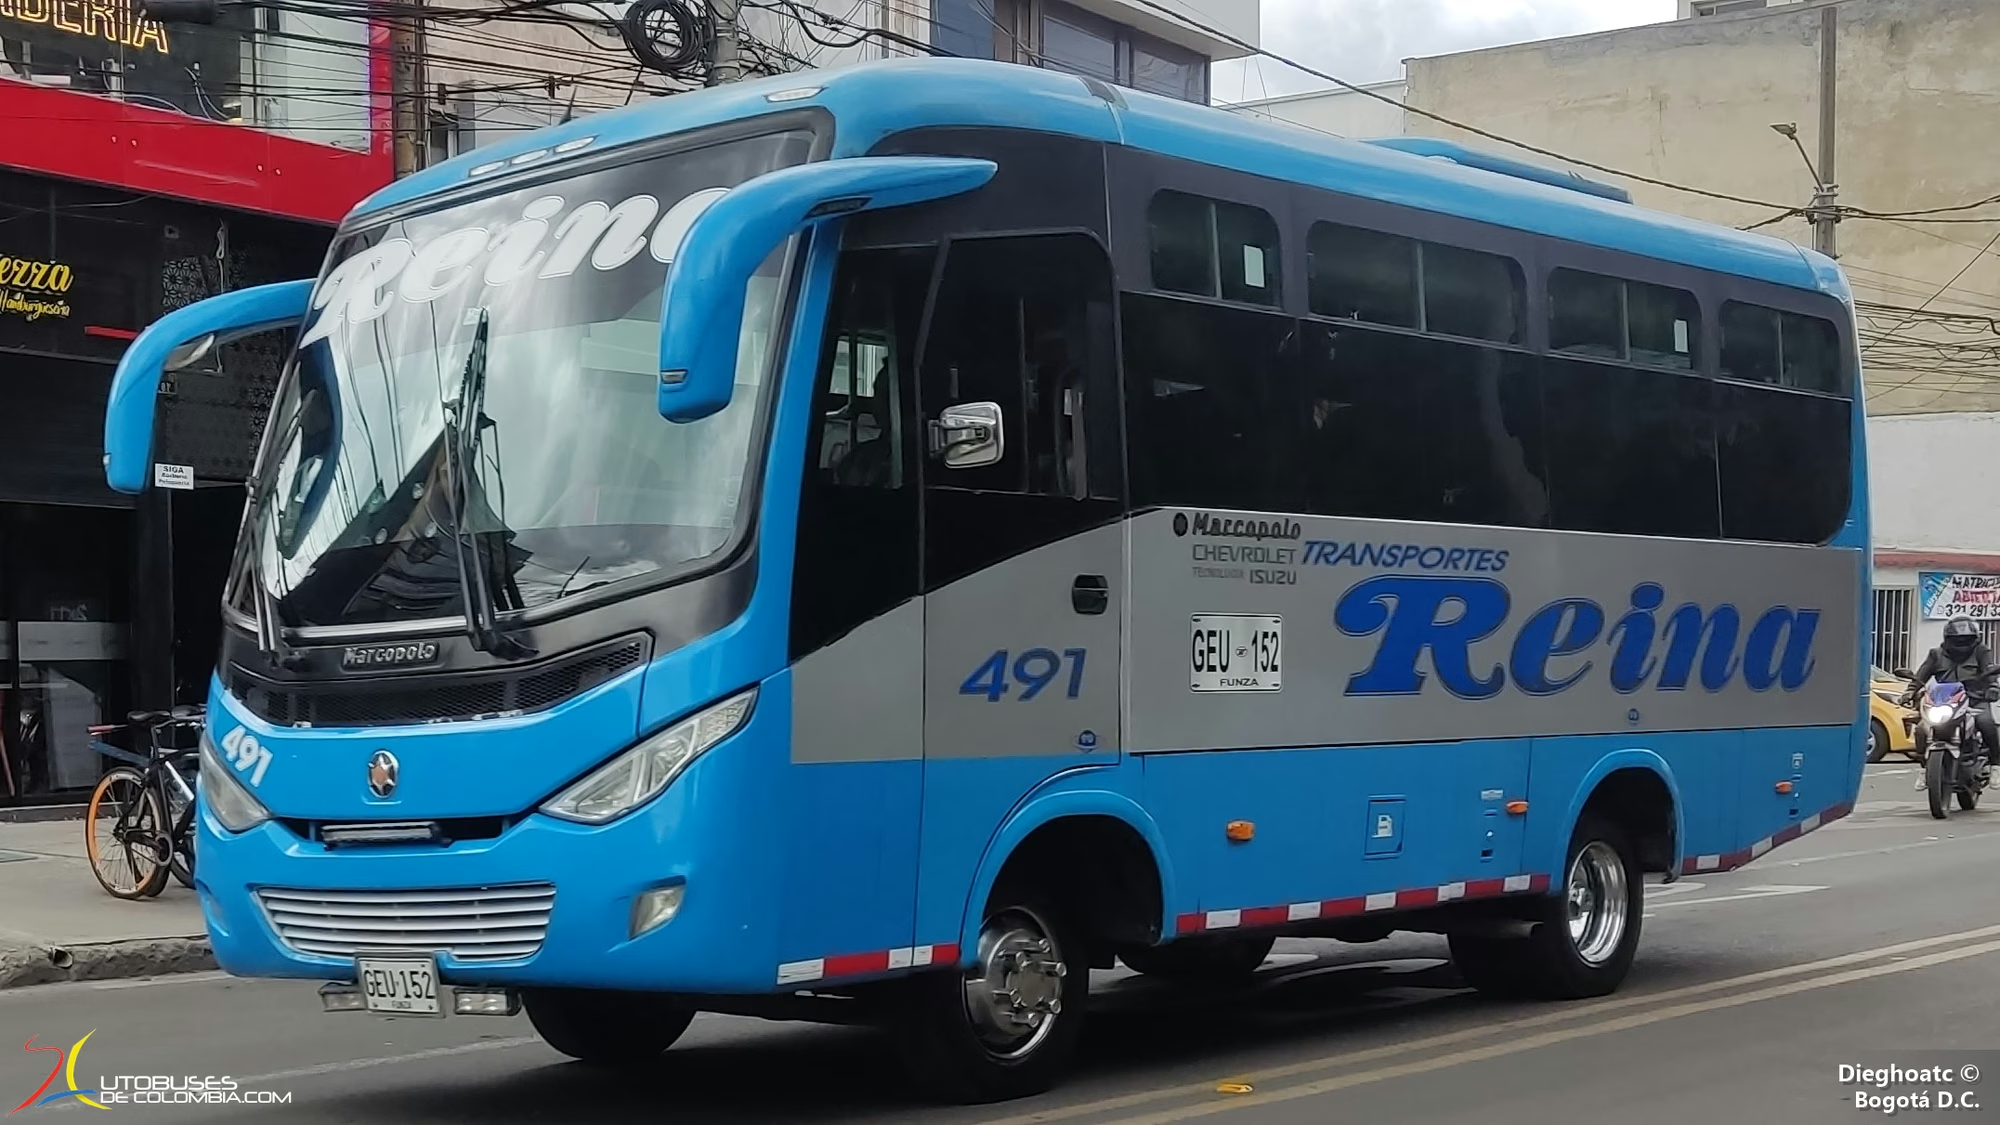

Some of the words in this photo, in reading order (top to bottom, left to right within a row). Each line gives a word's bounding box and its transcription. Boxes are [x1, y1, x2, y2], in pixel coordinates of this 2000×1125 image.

[1192, 512, 1301, 541] Marcopolo
[1192, 544, 1297, 564] CHEVROLET
[1301, 541, 1510, 571] TRANSPORTES
[1249, 569, 1297, 585] ISUZU
[1970, 603, 1989, 617] 291
[1192, 629, 1230, 673] GEU
[1251, 630, 1279, 673] 152
[1333, 574, 1822, 700] Reina
[342, 642, 435, 666] Marcopolo
[958, 648, 1087, 702] 491
[1220, 678, 1259, 687] FUNZA
[221, 724, 274, 787] 491
[364, 969, 396, 998] GEU
[399, 970, 435, 999] 152
